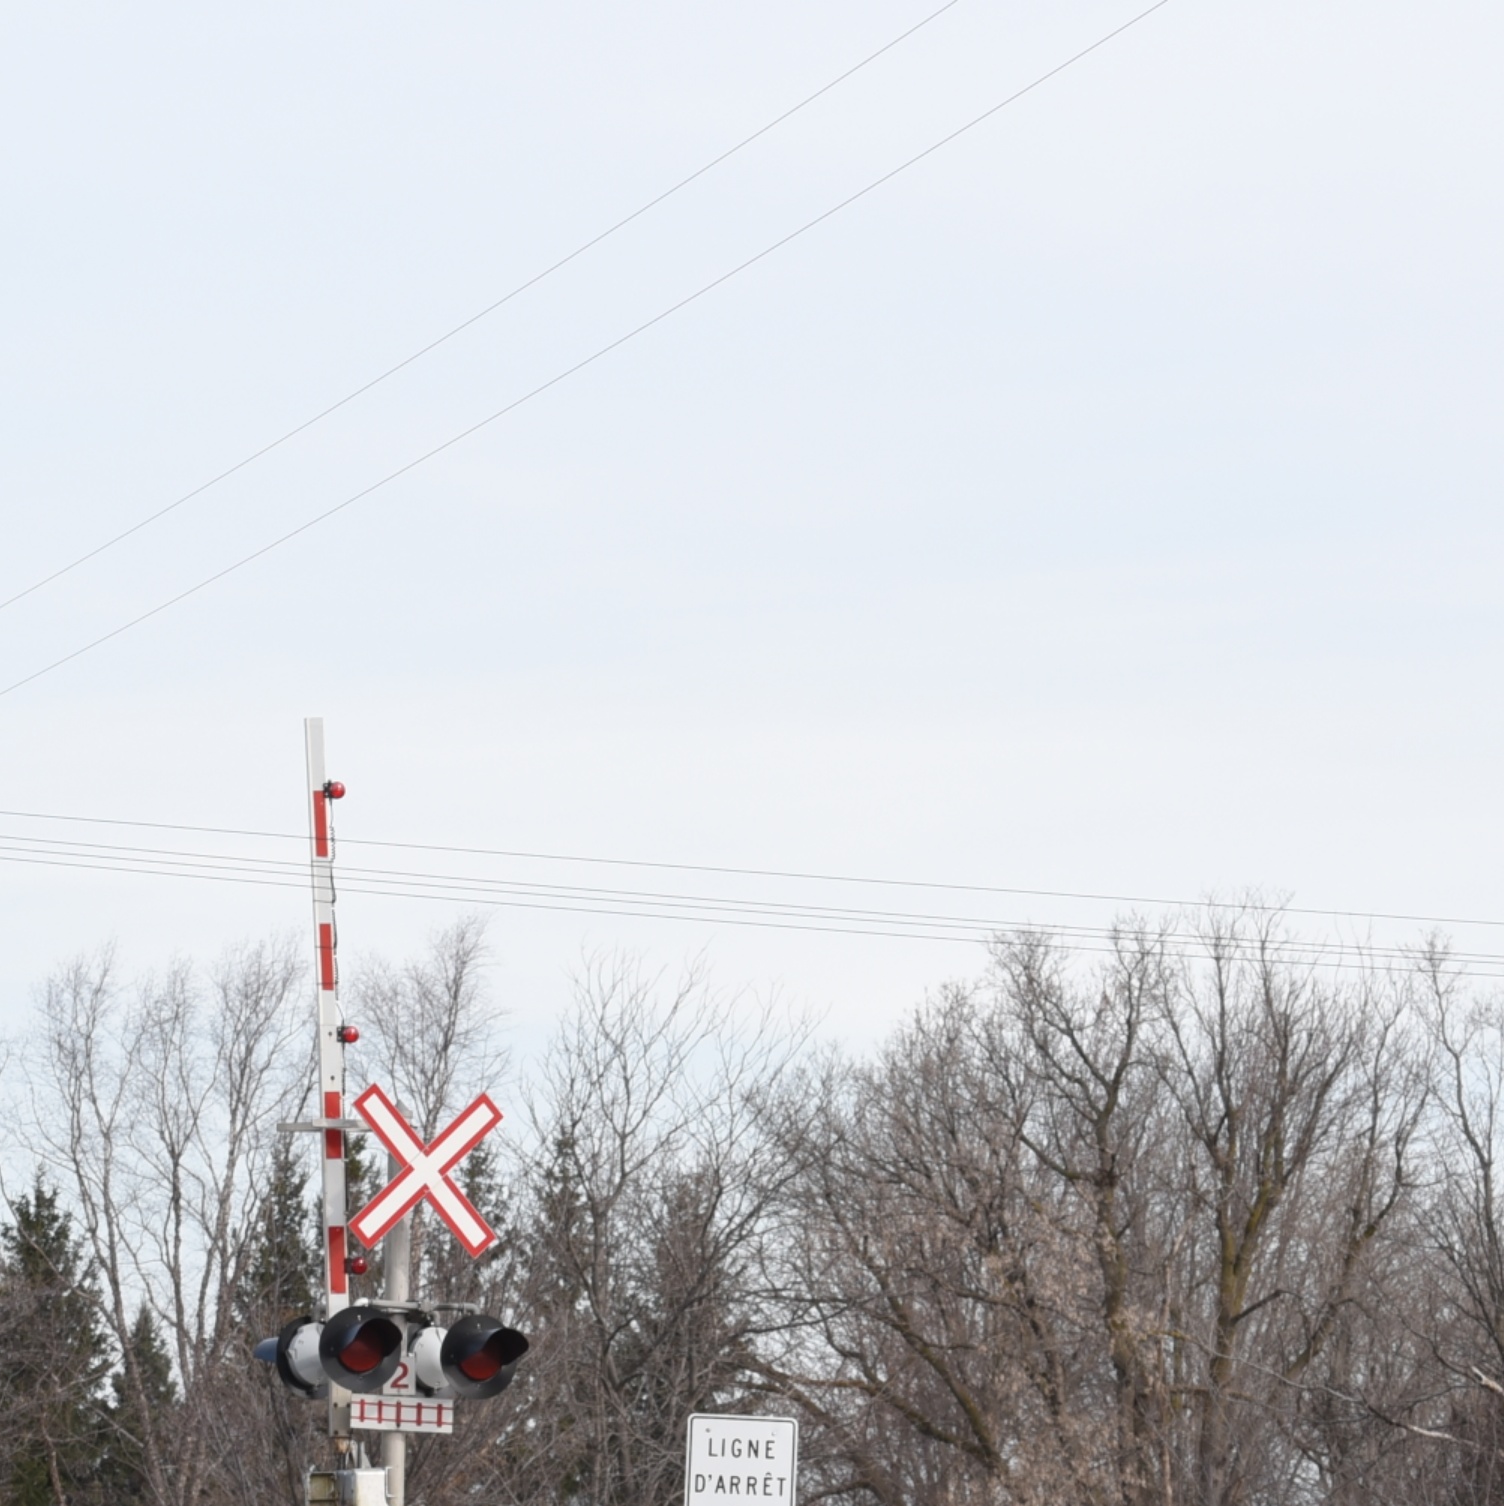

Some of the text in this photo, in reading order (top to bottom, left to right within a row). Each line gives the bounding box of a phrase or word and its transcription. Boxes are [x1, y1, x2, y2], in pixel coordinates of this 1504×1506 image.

[390, 1361, 410, 1389] 2
[708, 1437, 776, 1460] LIGNE
[694, 1471, 787, 1497] D'ARRÊT
